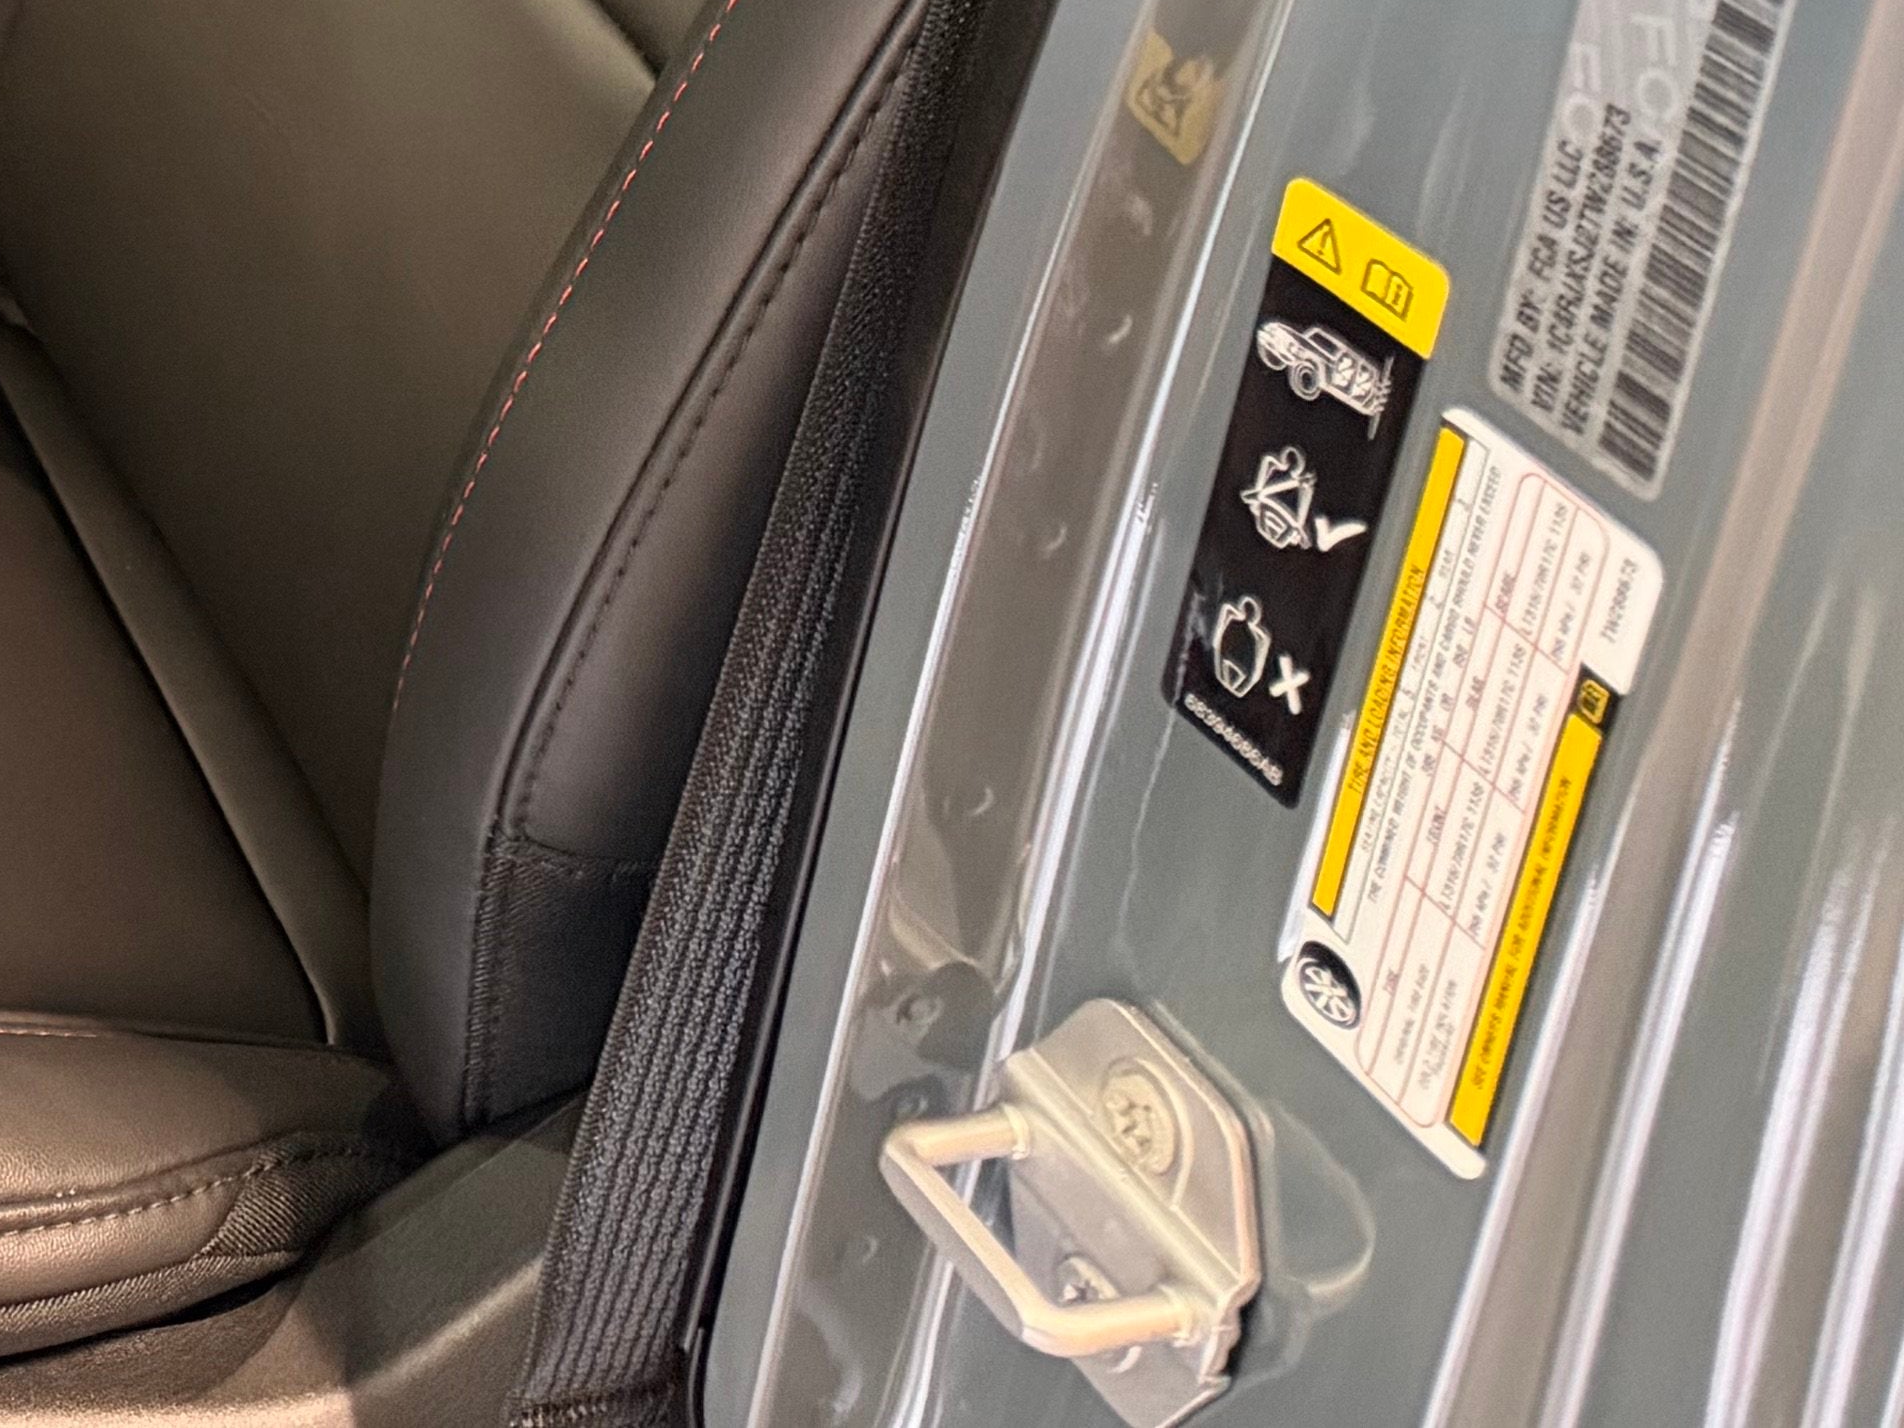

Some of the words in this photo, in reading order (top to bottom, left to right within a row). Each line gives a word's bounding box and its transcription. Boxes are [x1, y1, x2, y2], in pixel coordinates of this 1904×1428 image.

[1550, 135, 1585, 193] LLC
[1620, 127, 1662, 215] U.S.A.
[1539, 186, 1572, 233] US
[1609, 211, 1639, 257] IN:
[1525, 227, 1561, 286] FCA
[1513, 282, 1547, 336] BY:
[1588, 252, 1629, 335] MADE
[1497, 329, 1534, 396] MFD
[1528, 355, 1564, 418] VIN:
[1560, 329, 1608, 440] VEHICLE
[1383, 560, 1425, 667] INFORMATION
[1365, 661, 1396, 731] LOADING
[1358, 725, 1379, 763] AND
[1347, 760, 1369, 798] TIRE
[1367, 878, 1382, 905] THE
